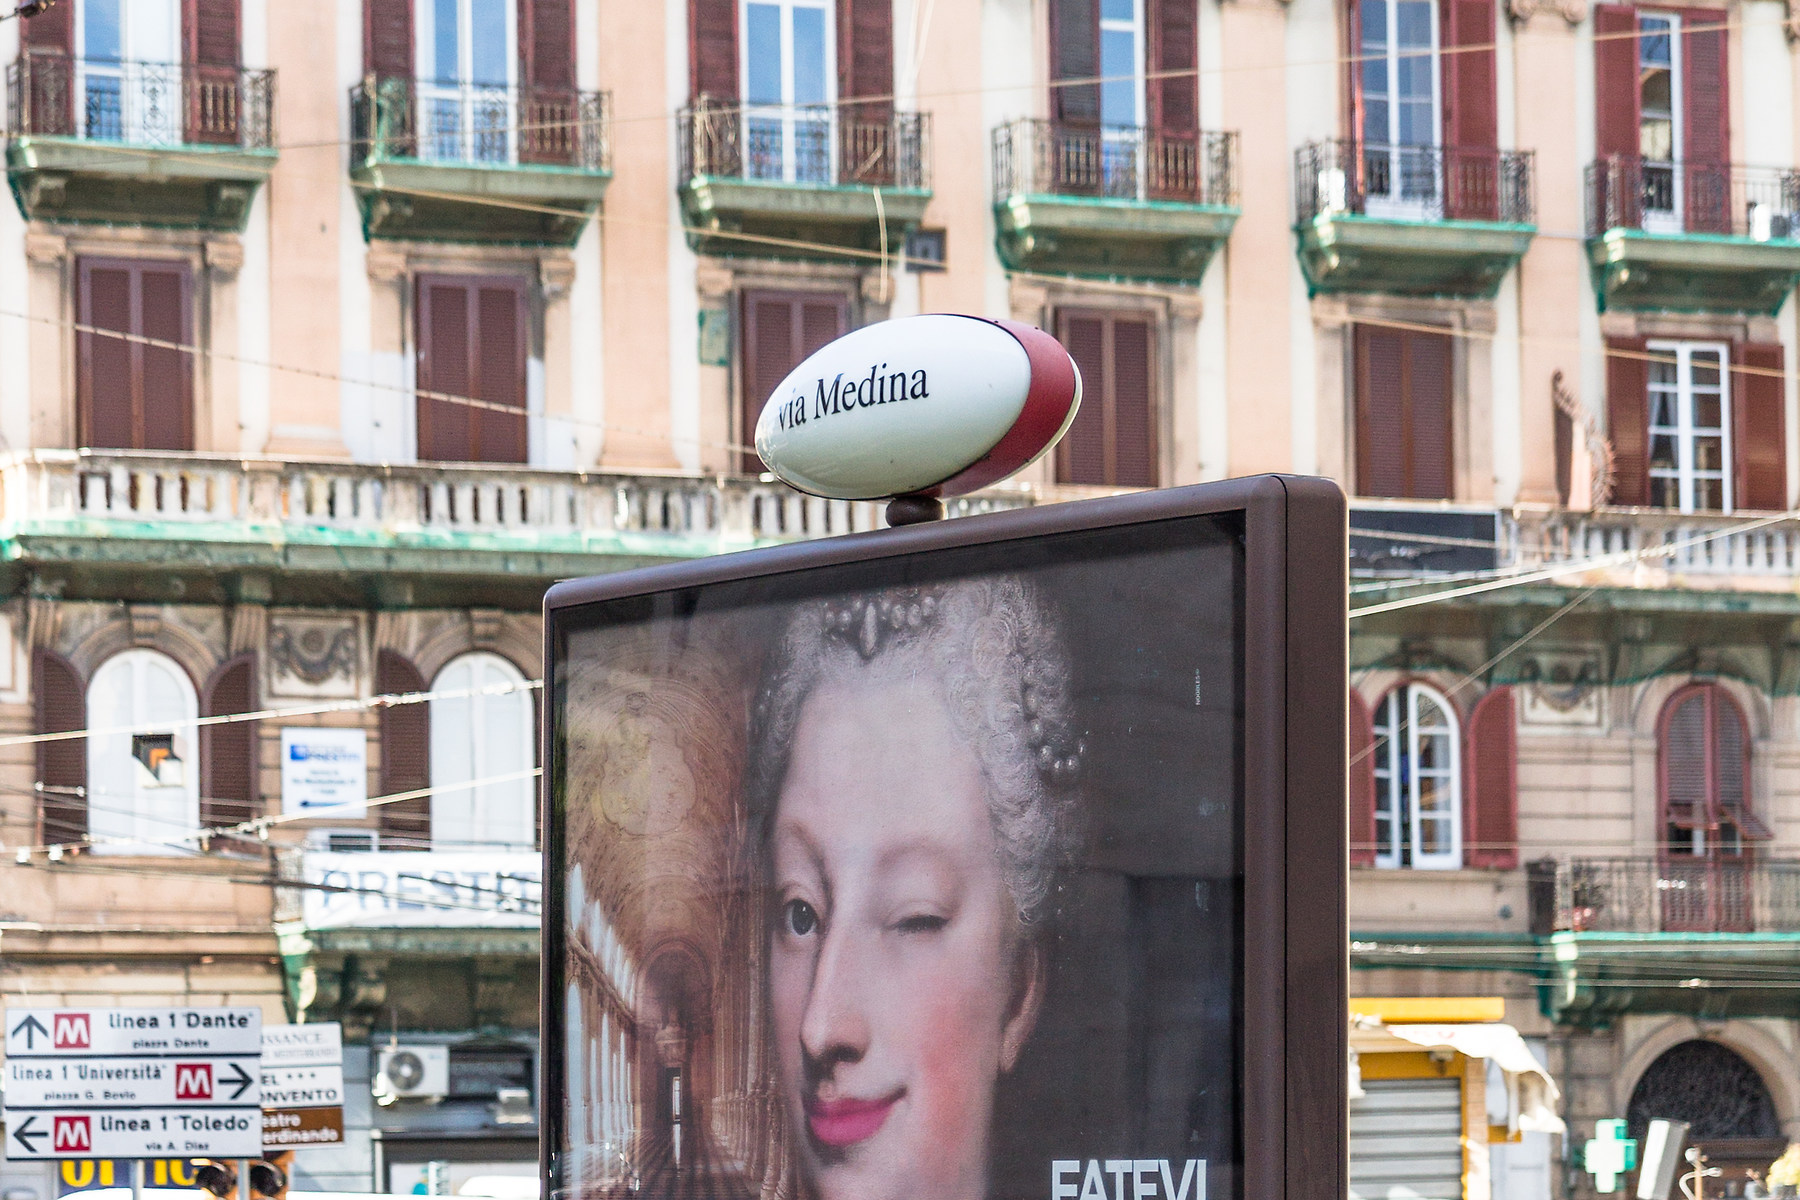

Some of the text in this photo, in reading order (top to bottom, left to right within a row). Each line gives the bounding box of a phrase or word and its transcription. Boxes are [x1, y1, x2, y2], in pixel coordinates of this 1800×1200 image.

[779, 363, 929, 432] via Medina
[109, 1013, 159, 1029] linea
[168, 1013, 176, 1029] 1
[12, 1064, 53, 1080] linea
[62, 1064, 68, 1080] 1
[100, 1115, 151, 1131] linea
[160, 1116, 168, 1131] 1
[146, 1142, 162, 1151] via
